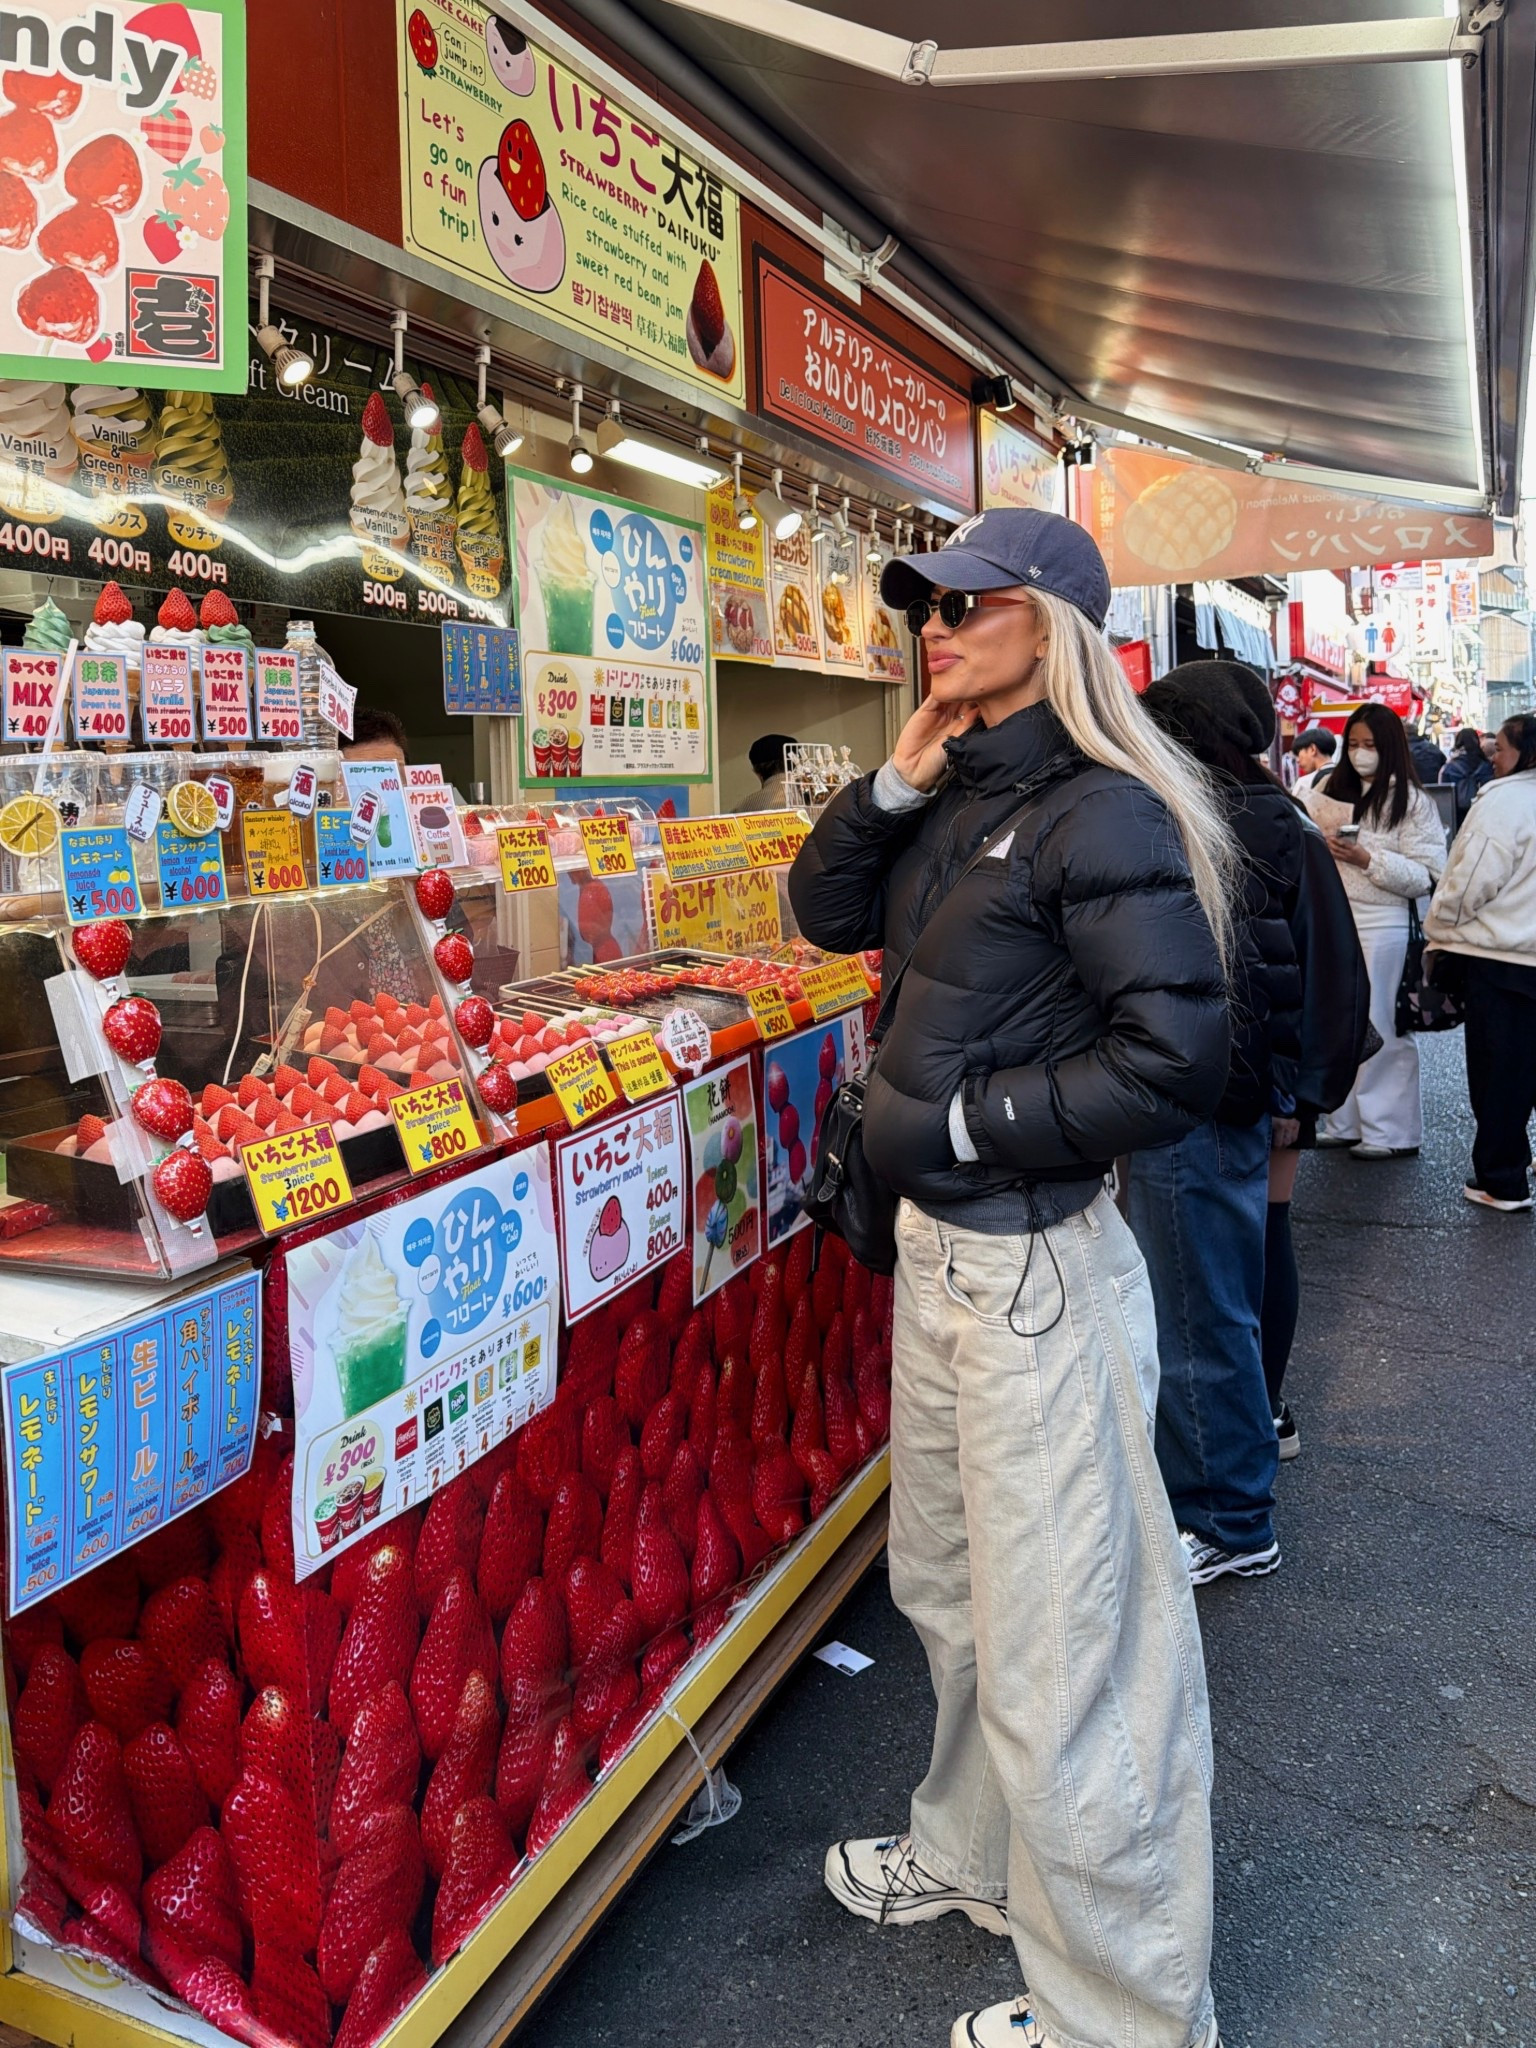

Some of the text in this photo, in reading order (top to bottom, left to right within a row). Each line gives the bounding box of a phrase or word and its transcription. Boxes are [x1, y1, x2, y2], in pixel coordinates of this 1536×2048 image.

[456, 9, 483, 36] CAKE
[444, 30, 467, 53] Can i
[445, 44, 483, 77] jump in?
[439, 65, 502, 113] STRAWBERRY
[422, 98, 464, 142] Let's
[430, 143, 472, 179] go on
[548, 64, 724, 242] いちご大福
[424, 171, 466, 206] a fun
[560, 148, 648, 218] STRAWBERRY
[439, 206, 476, 243] trip!
[562, 182, 687, 272] Rice cake stuffed with
[586, 229, 669, 287] strawberry and
[576, 252, 683, 321] sweet red bean jam
[779, 378, 820, 416] Delicious
[1, 434, 57, 460] Vanilla
[91, 424, 138, 449] Vanilla
[111, 444, 121, 458] &
[83, 454, 149, 481] Green tea
[161, 470, 225, 495] Green tea
[364, 517, 398, 536] Vanilla
[413, 518, 450, 535] Vanilla &
[0, 522, 70, 562] 400円
[413, 531, 453, 548] Green tea
[461, 540, 499, 557] Green tea
[88, 536, 151, 574] 400円
[431, 548, 437, 557] &
[474, 556, 490, 569] 抹茶
[716, 549, 755, 573] strawberry
[774, 545, 809, 566] メロンパン
[168, 550, 228, 584] 400円
[710, 566, 764, 590] cream melon pan
[363, 580, 407, 611] 500円
[418, 590, 458, 617] 500円
[628, 619, 665, 643] フロート
[9, 659, 57, 676] みっくす
[205, 651, 243, 665] みっくす
[81, 660, 117, 683] 抹茶
[264, 668, 292, 687] 抹茶
[547, 672, 568, 684] Drink
[13, 682, 53, 707] MIX
[82, 686, 120, 696] Japanese
[150, 679, 185, 693] バニラ
[212, 683, 239, 702] MIX
[264, 687, 295, 696] Japanese
[152, 693, 184, 706] Vanilla
[296, 771, 315, 797] 酒
[411, 770, 440, 785] 300円
[290, 798, 312, 810] alcohol
[357, 798, 377, 823] 酒
[351, 822, 372, 836] alcohol
[426, 830, 450, 839] Coffee
[581, 820, 628, 838] いちご大福
[744, 817, 784, 830] Strawberry
[160, 842, 217, 855] レモンサワー
[499, 829, 548, 848] いちご大福
[67, 867, 101, 878] lemonade
[76, 881, 96, 891] juice
[615, 1060, 638, 1073] This is
[393, 1081, 464, 1121] いちご大福
[707, 1076, 731, 1111] 花餅
[1003, 1096, 1015, 1121] 700
[426, 1119, 451, 1134] 2piece
[246, 1126, 335, 1172] いちご大福
[572, 1105, 674, 1187] いちご大福
[260, 1162, 309, 1184] Strawberry
[284, 1171, 315, 1190] 3piece
[575, 1161, 643, 1206] Strawberry mochi
[645, 1179, 678, 1211] 400円
[646, 1225, 677, 1260] 800円
[446, 1294, 494, 1328] フロート
[200, 1307, 212, 1371] サントリー
[243, 1306, 254, 1382] ウイスキー
[100, 1347, 112, 1399] 生しぼり
[226, 1320, 241, 1434] レモネード
[44, 1369, 57, 1425] 生しぼり
[179, 1318, 200, 1474] 角ハイボール
[131, 1339, 159, 1483] 生ビール
[78, 1373, 99, 1520] レモンサワー
[340, 1426, 367, 1449] Drink
[18, 1393, 46, 1527] レモネード
